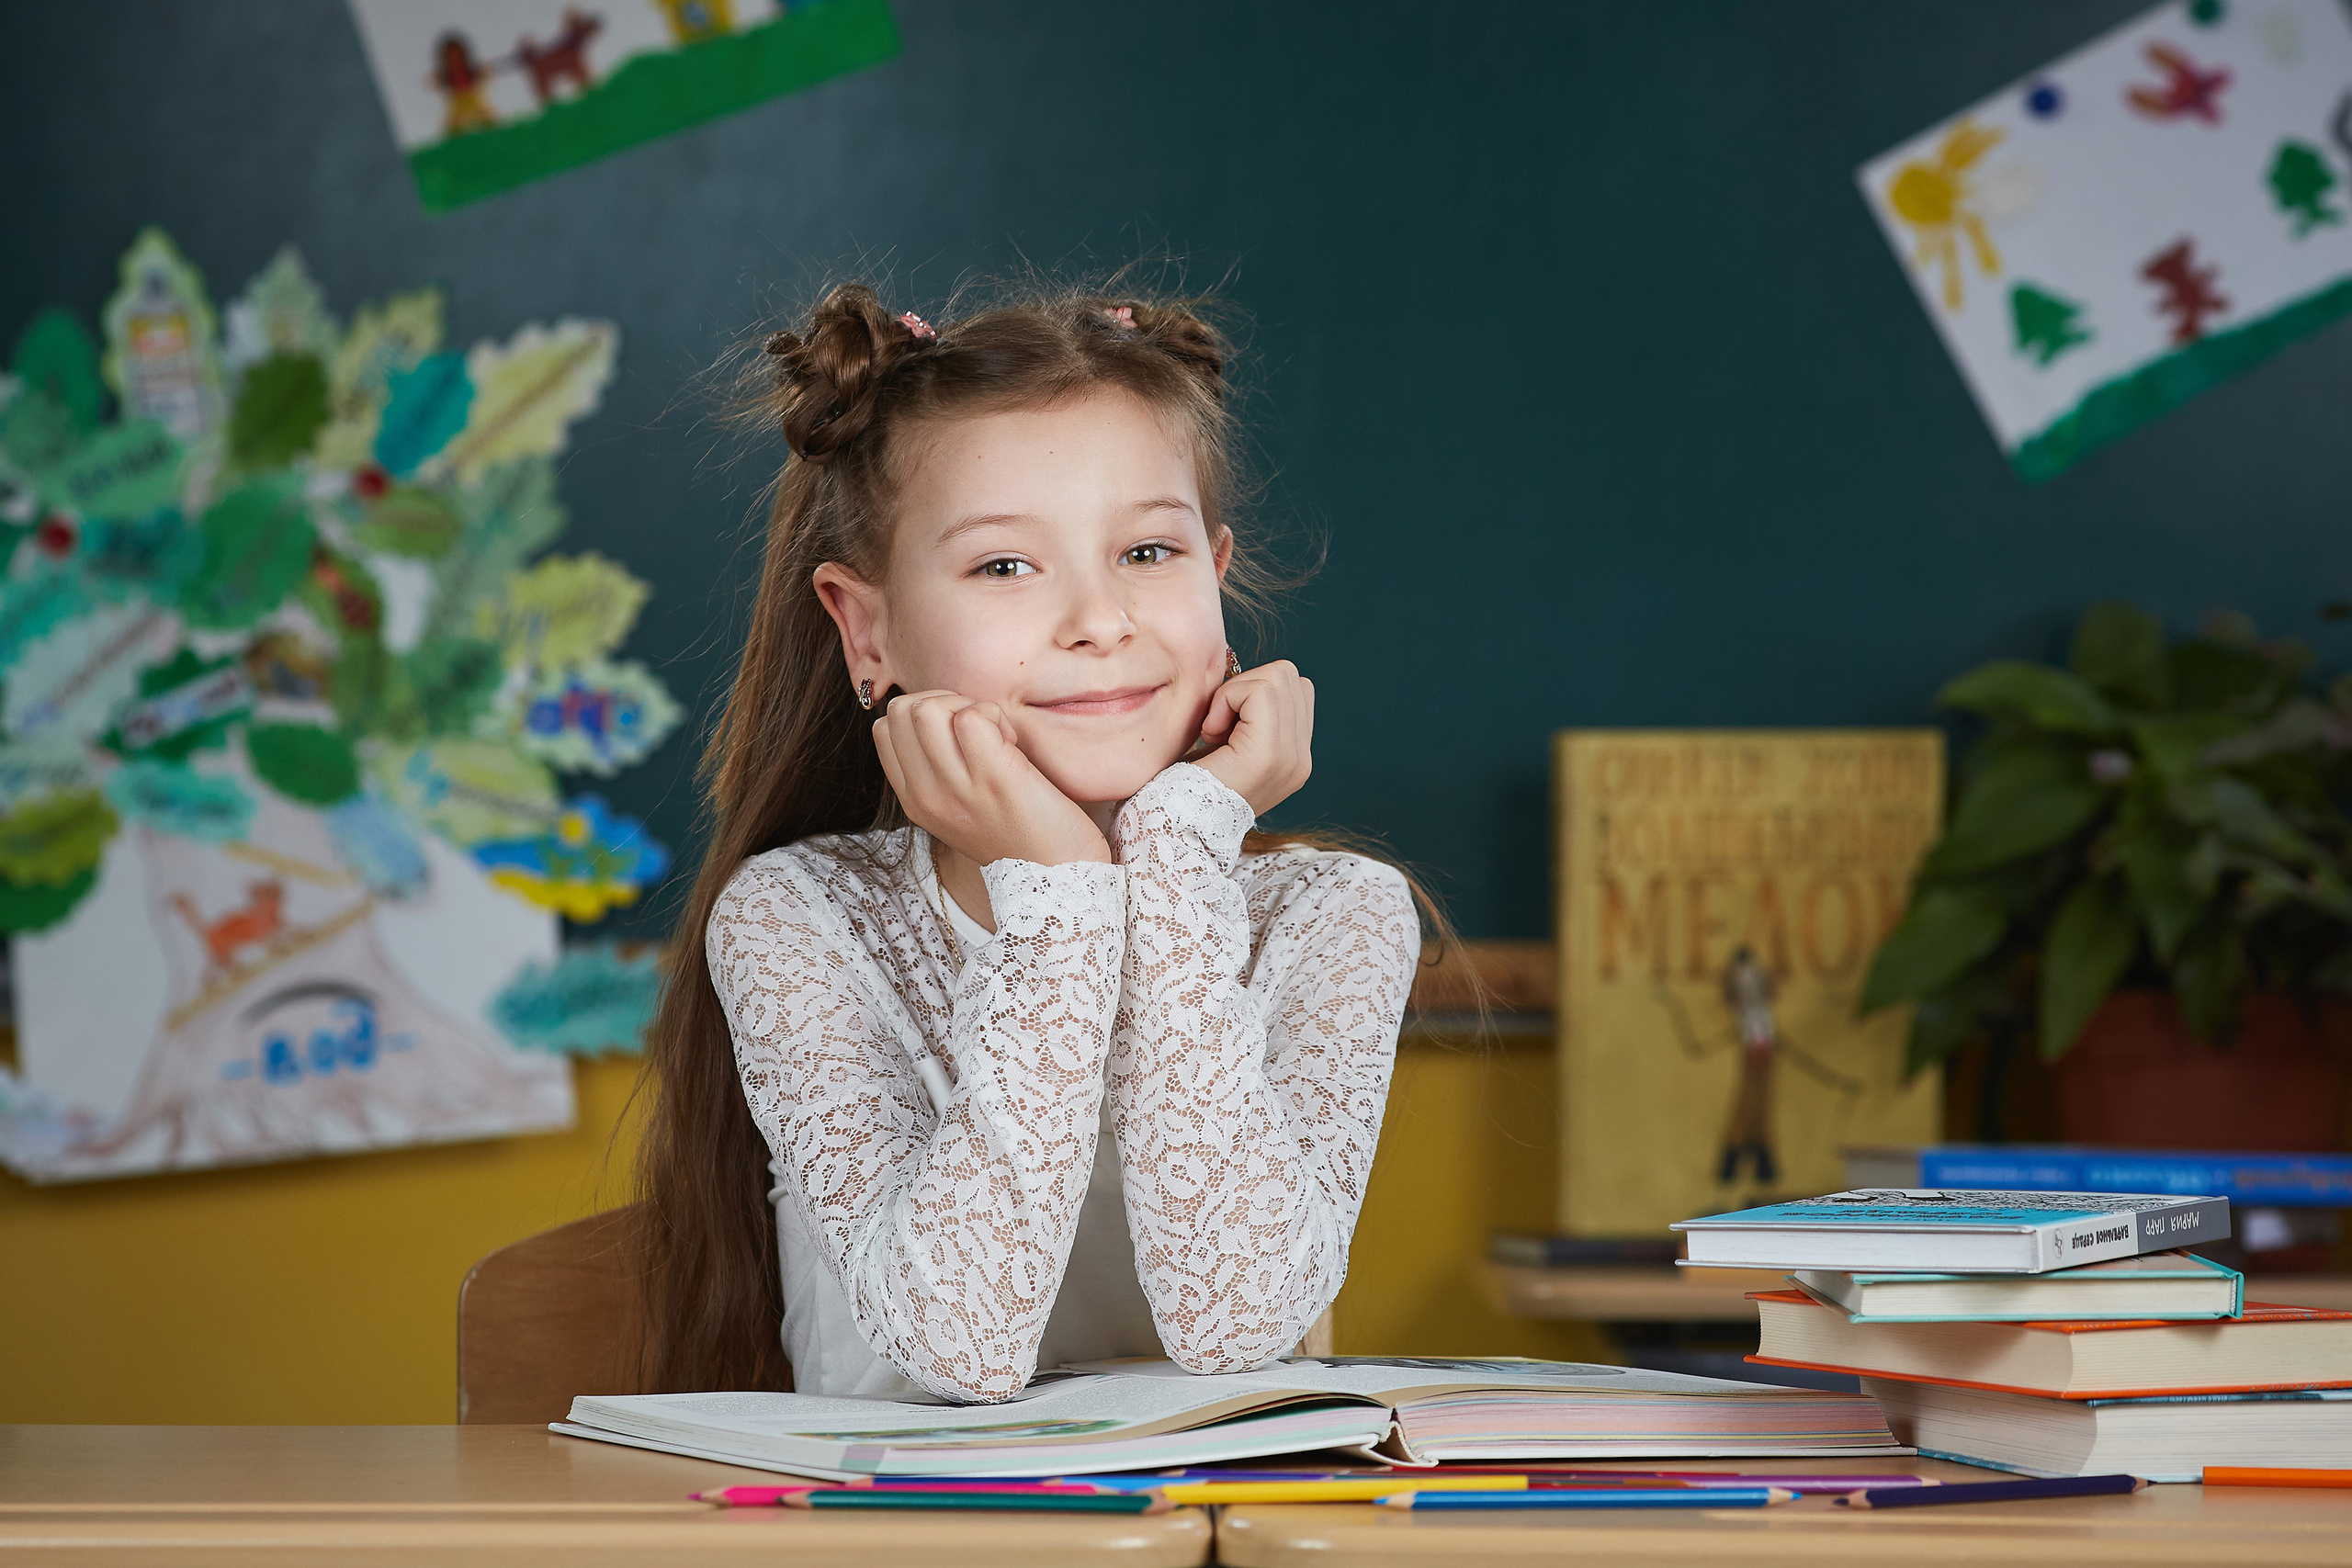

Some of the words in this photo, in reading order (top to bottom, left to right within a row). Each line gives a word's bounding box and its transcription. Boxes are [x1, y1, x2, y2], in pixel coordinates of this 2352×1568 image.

[2145, 1216, 2165, 1236] ПАРР
[2170, 1212, 2199, 1232] МАРИЯ
[2072, 1233, 2094, 1249] СЕРДЦЕ
[2096, 1224, 2130, 1246] ВАФЕЛЬНОЕ
